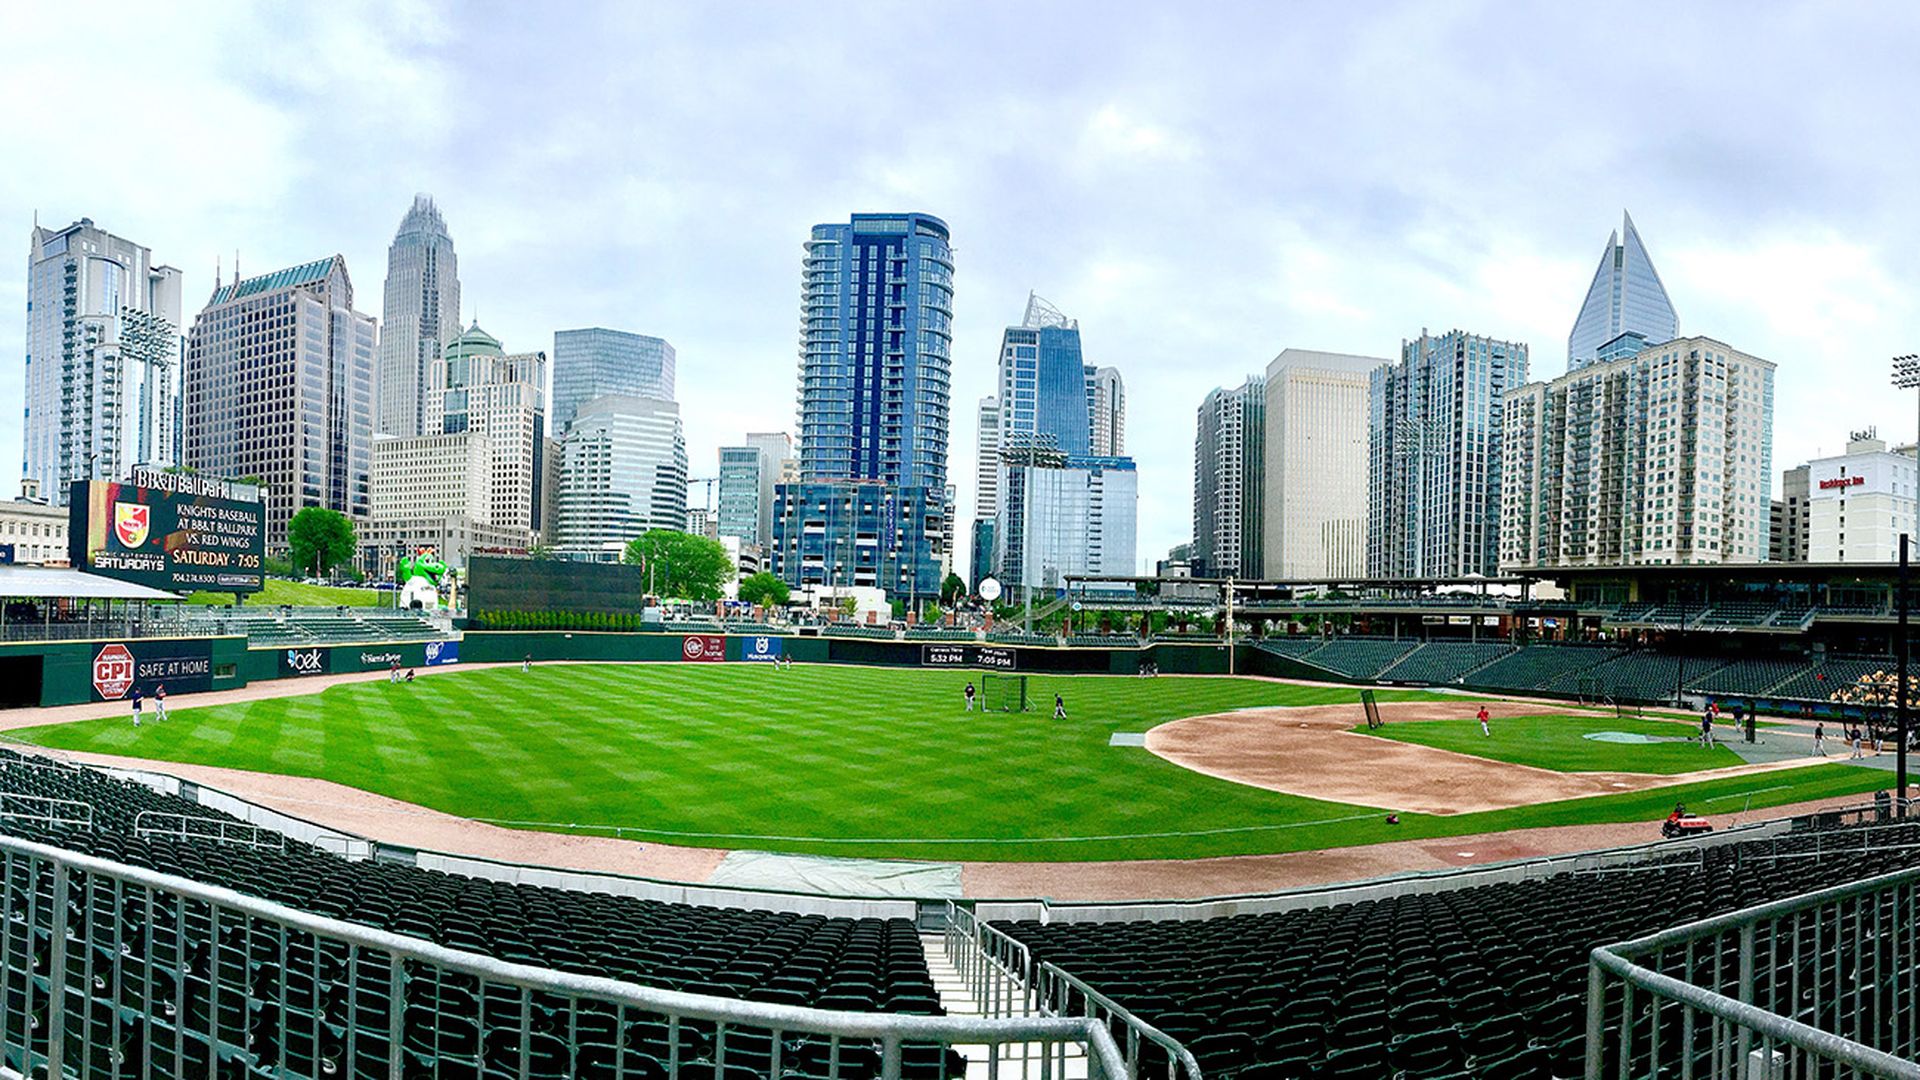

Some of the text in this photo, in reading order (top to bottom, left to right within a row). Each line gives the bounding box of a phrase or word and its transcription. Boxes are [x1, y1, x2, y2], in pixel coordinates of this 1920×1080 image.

[178, 476, 230, 500] BallPark
[177, 503, 258, 524] KNIGHTS BASEBALL
[177, 518, 258, 536] AT BB&T BALLPARK
[201, 534, 219, 546] RED
[220, 536, 250, 548] WINGS
[94, 557, 165, 571] SATURDAYS
[173, 549, 230, 566] SATURDAY
[238, 554, 260, 568] 7:05
[949, 654, 962, 662] PM
[977, 655, 1011, 666] 7:05 PM
[97, 662, 131, 680] CPI
[139, 660, 208, 677] SAFE AT HOME
